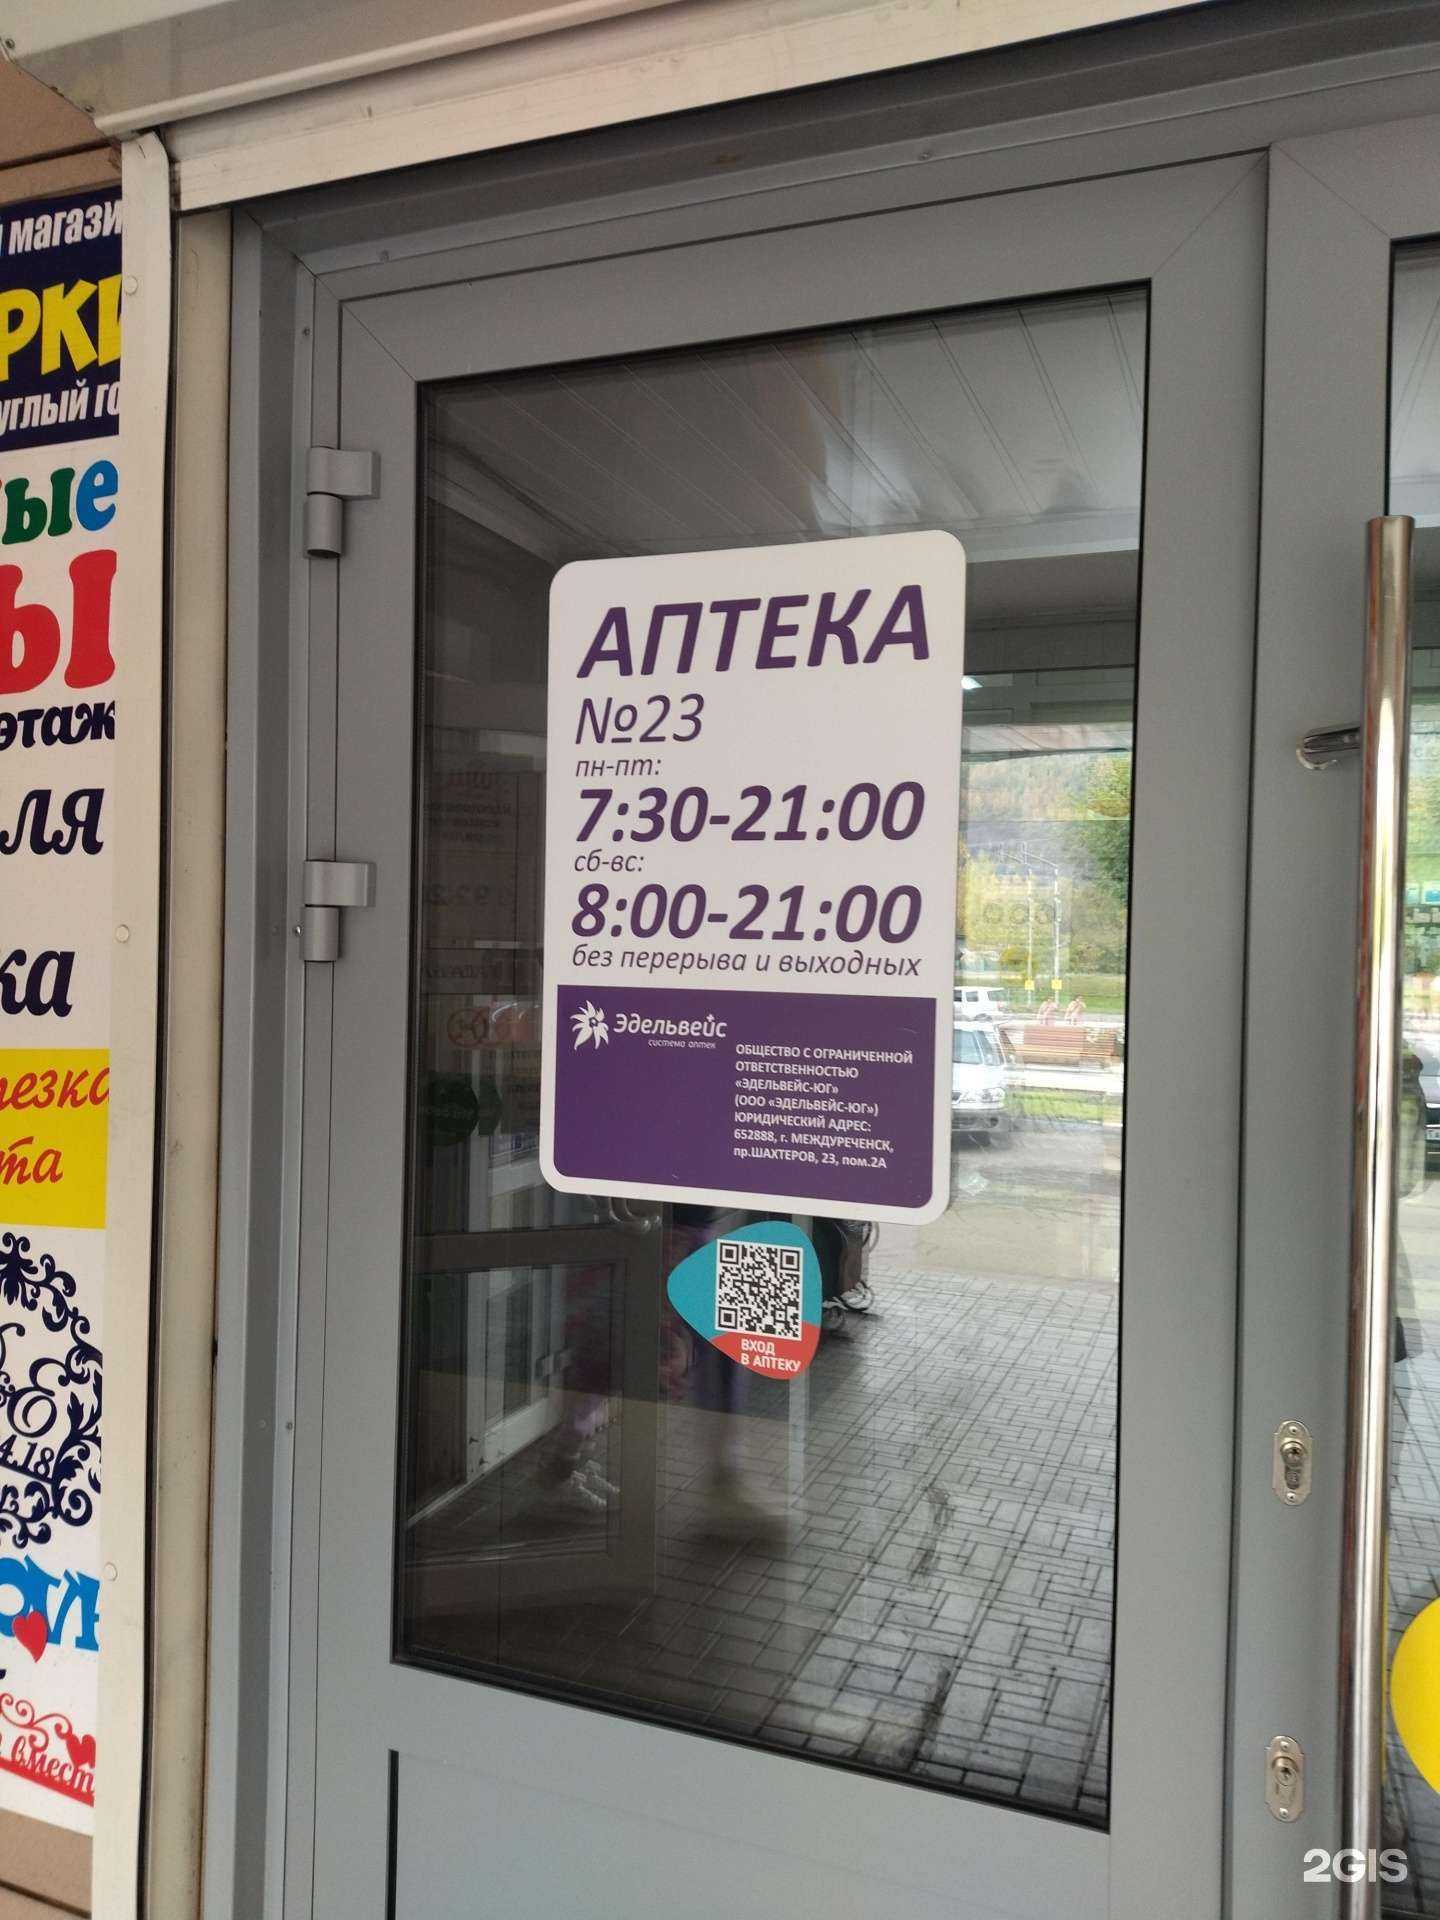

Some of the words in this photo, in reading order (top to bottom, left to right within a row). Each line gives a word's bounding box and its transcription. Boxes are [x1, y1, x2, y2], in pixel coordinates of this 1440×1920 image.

[576, 584, 930, 678] АПТЕКА
[575, 693, 705, 744] №23
[575, 756, 663, 777] пн-пт:
[576, 781, 925, 842] 7:30-21:00
[574, 849, 645, 872] сб-вс:
[571, 883, 922, 944] 8:00-21:00
[572, 943, 613, 967] без
[620, 949, 746, 975] перерыва
[755, 953, 770, 971] и
[778, 950, 922, 976] выходных
[614, 1013, 727, 1038] Эдельвейс
[648, 1039, 686, 1048] система
[688, 1041, 716, 1049] аптек
[735, 1044, 801, 1057] ОБЩЕСТВО
[803, 1047, 811, 1058] С
[815, 1047, 913, 1064] ОГРАНИЧЕННОЙ
[735, 1061, 859, 1078] ОТВЕТСТВЕННОСТЬЮ
[735, 1078, 839, 1095] «ЭДЕЛЬВЕЙС-ЮГ»
[734, 1094, 766, 1107] (ООО
[768, 1097, 879, 1116] «ЭДЕЛЬВЕЙС-ЮГ»)
[734, 1112, 825, 1129] ЮРИДИЧЕСКИЙ
[828, 1120, 871, 1132] АДРЕС:
[734, 1129, 777, 1143] 652888,
[780, 1134, 788, 1143] г.
[791, 1133, 894, 1153] МЕЖДУРЕЧЕНСК,
[821, 1153, 839, 1167] 23,
[842, 1155, 888, 1168] пом.2А
[741, 1339, 775, 1355] ВХОД
[740, 1353, 750, 1365] В
[753, 1355, 800, 1372] АПТЕКУ
